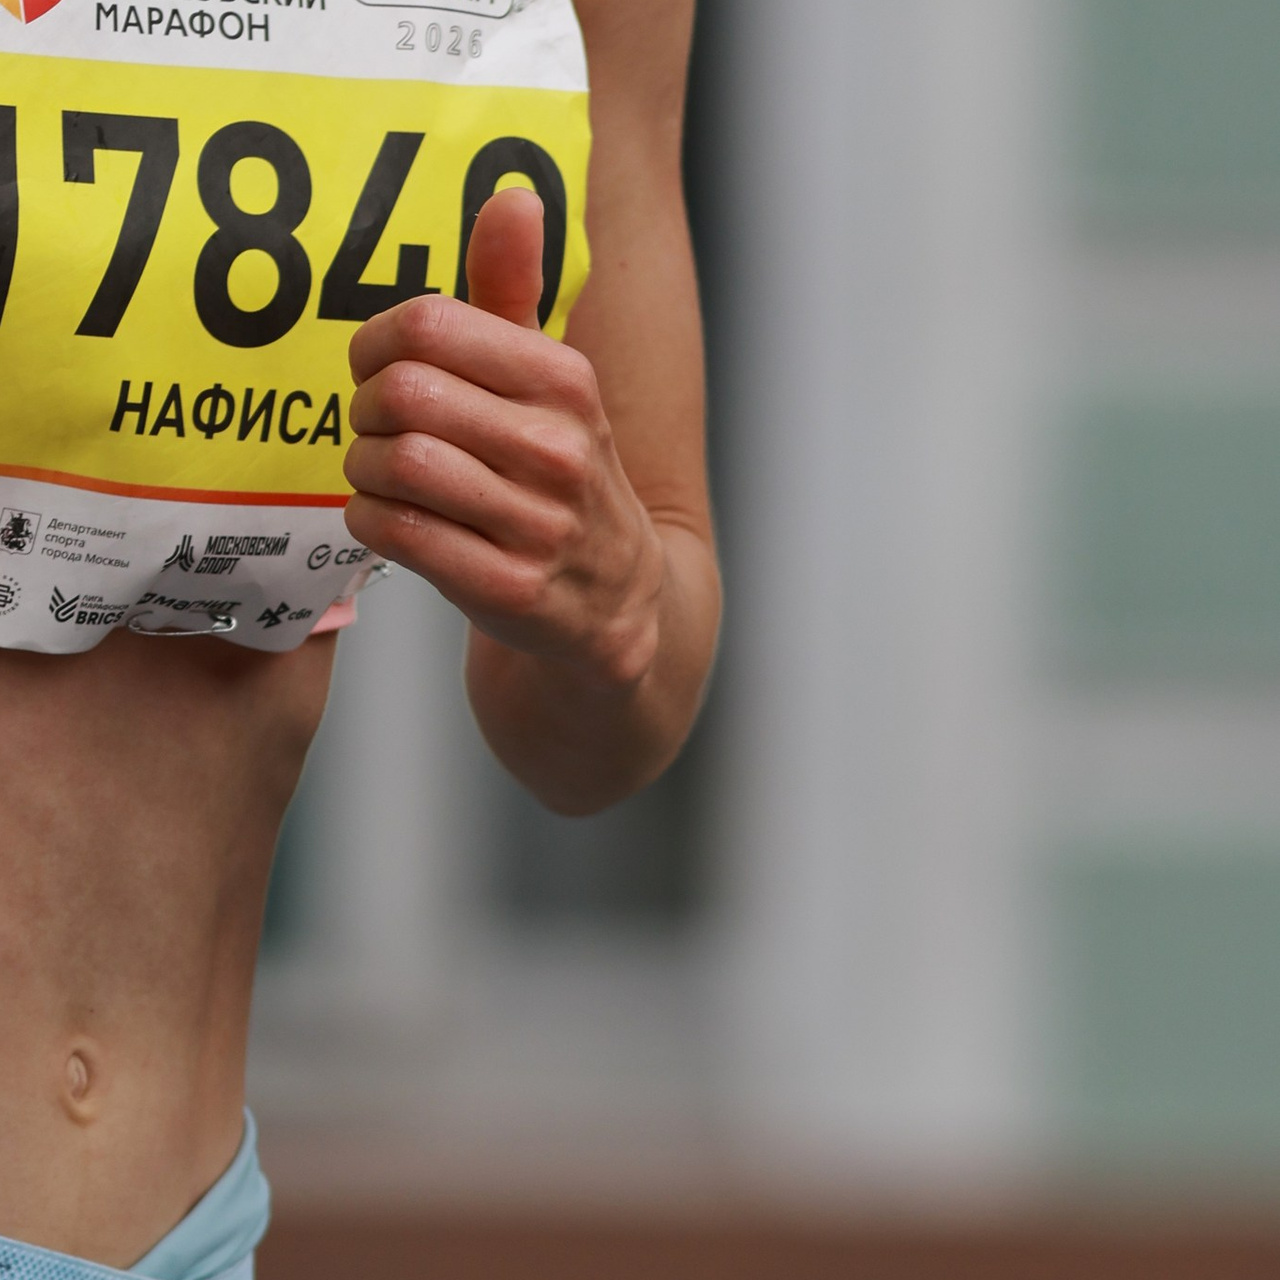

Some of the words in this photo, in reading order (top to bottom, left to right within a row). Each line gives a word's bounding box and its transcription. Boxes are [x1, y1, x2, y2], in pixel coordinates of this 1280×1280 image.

[96, 2, 269, 41] МАРАФОН
[395, 20, 483, 58] 2026
[109, 379, 343, 447] НАФИСА
[47, 518, 127, 540] Департамент
[44, 532, 86, 549] спорта
[204, 532, 291, 556] МОСКОВСКИЙ
[41, 545, 82, 562] города
[84, 553, 131, 568] Москвы
[194, 557, 240, 575] СПОРТ
[334, 547, 371, 566] СБЕ
[82, 594, 104, 602] ЛИГА
[75, 611, 125, 625] BRICS
